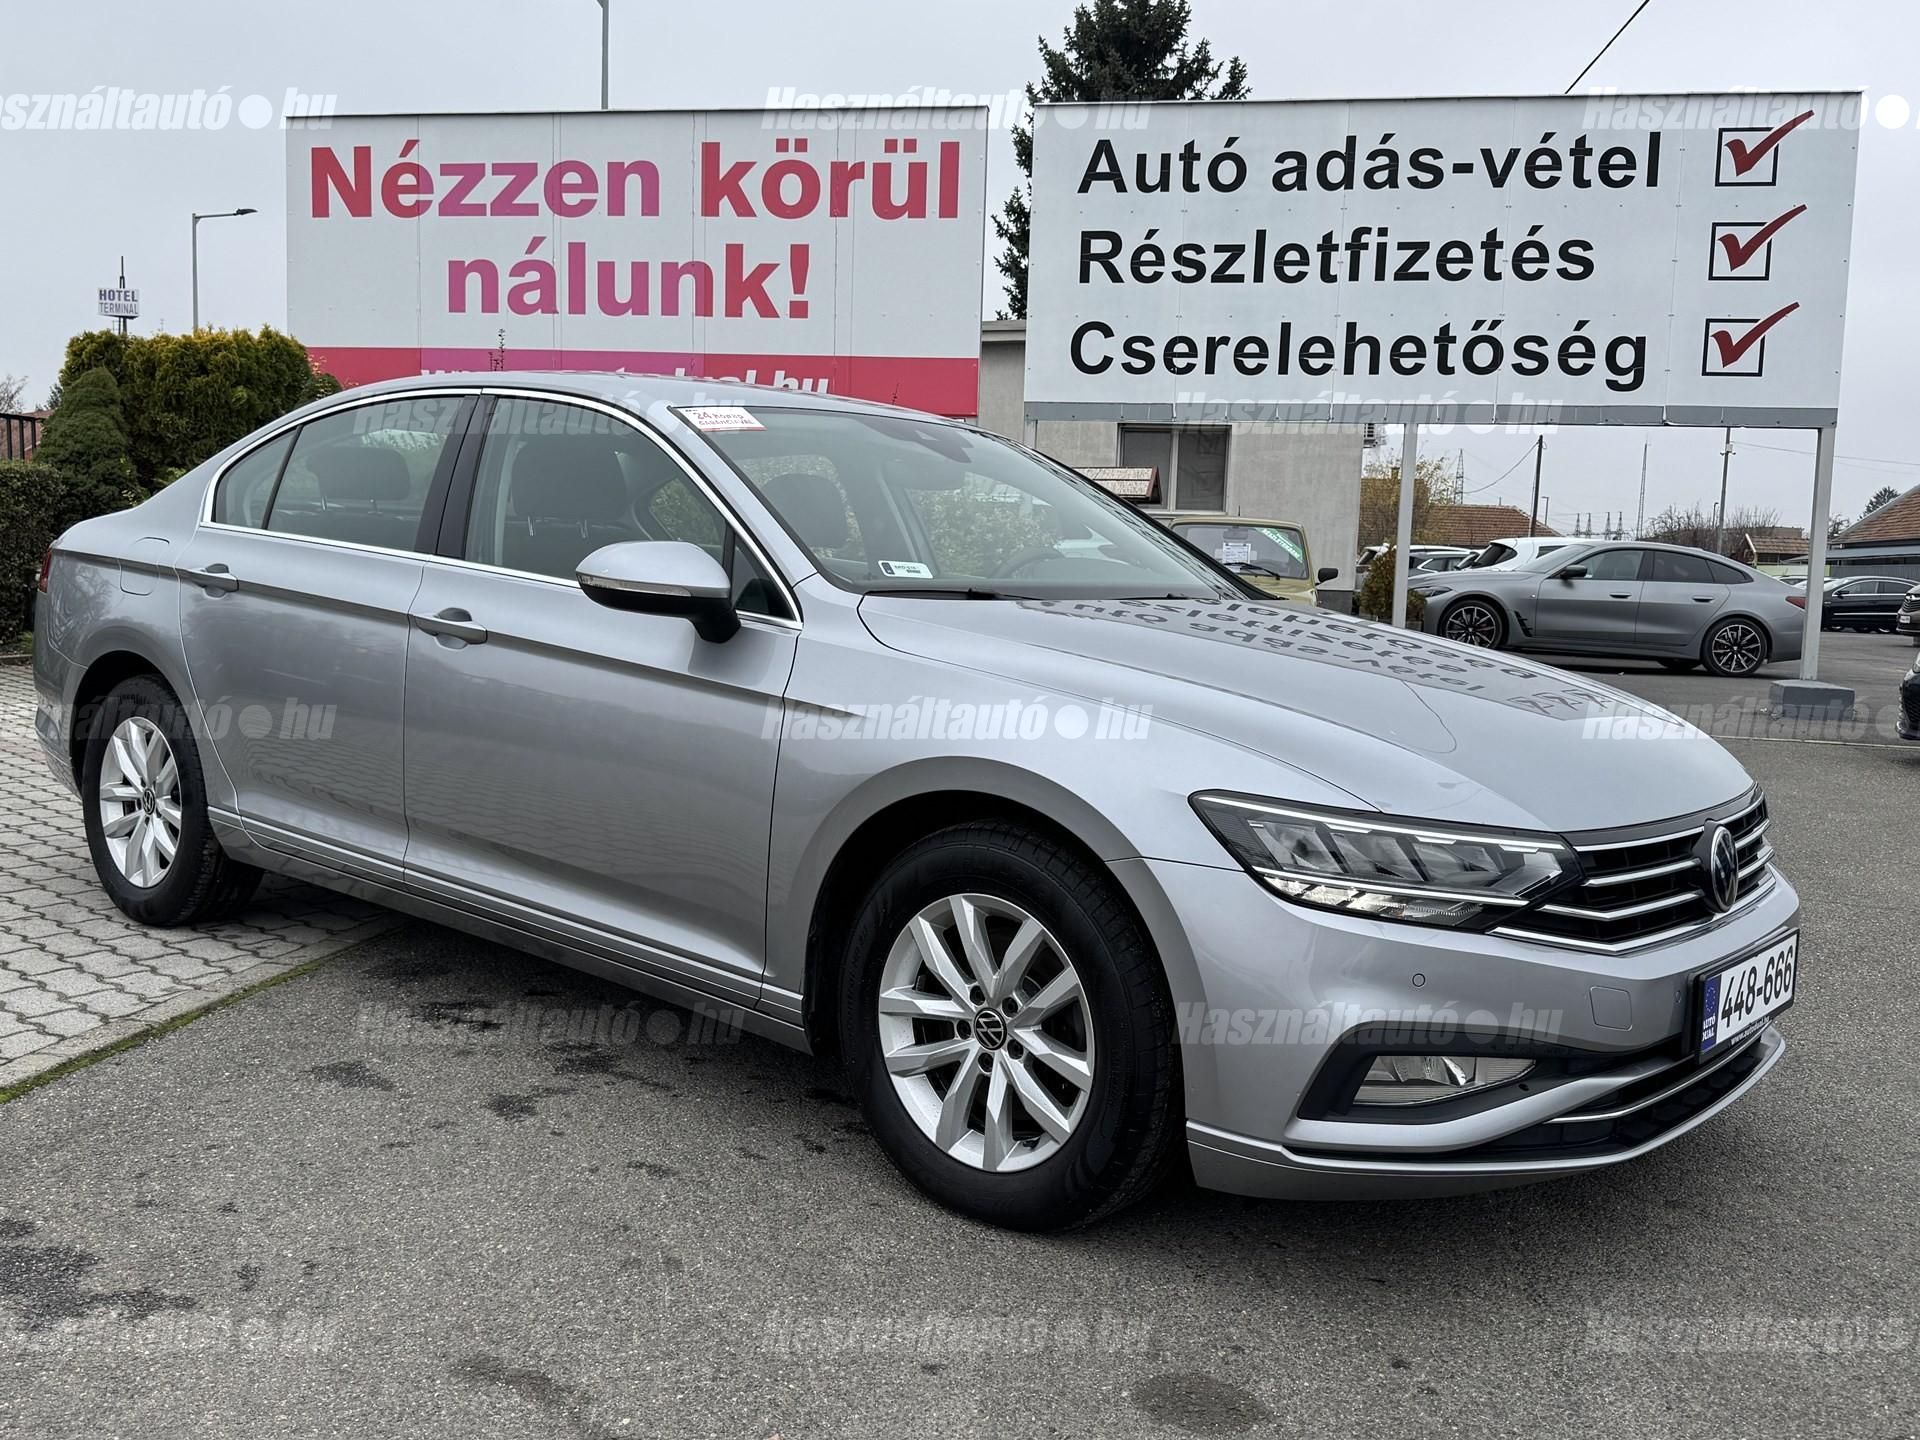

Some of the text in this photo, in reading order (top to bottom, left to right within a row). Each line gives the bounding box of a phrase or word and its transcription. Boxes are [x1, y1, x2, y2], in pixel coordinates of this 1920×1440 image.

[311, 138, 959, 220] Nézzen körül
[1078, 131, 1660, 194] Autó adás-vétel
[448, 236, 809, 319] nálunk!
[1080, 224, 1595, 284] Részletfizetés
[98, 289, 138, 302] HOTEL
[98, 302, 139, 315] TERMINAL
[1071, 319, 1646, 392] Cserelehetőség
[1721, 945, 1794, 1029] 448-666
